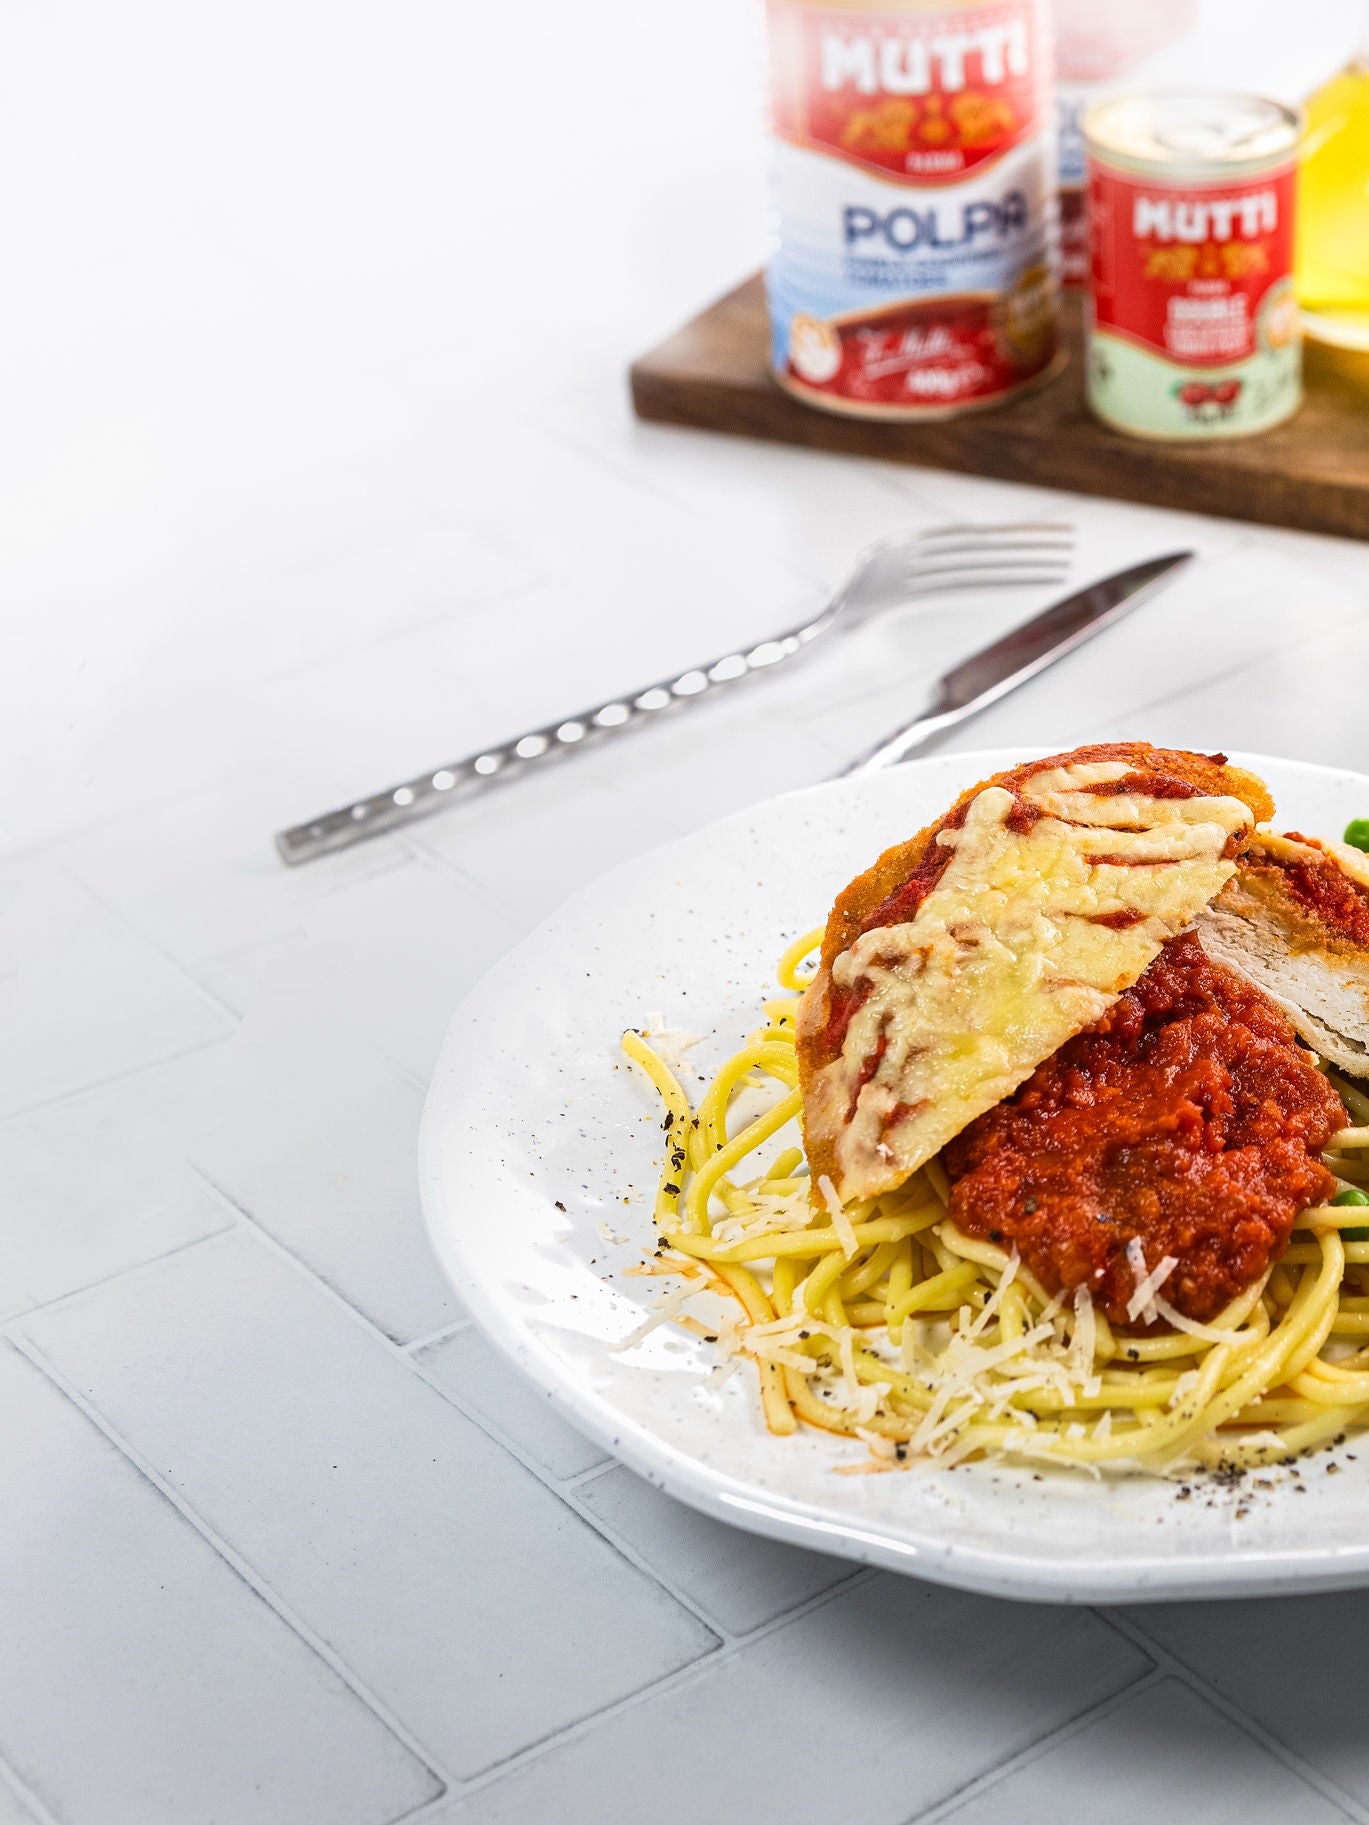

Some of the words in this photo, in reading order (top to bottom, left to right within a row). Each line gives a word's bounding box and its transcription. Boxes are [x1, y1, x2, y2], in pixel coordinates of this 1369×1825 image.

[821, 22, 1027, 94] MUTTI
[844, 195, 1026, 252] POLPA
[1133, 192, 1278, 241] MUTTI
